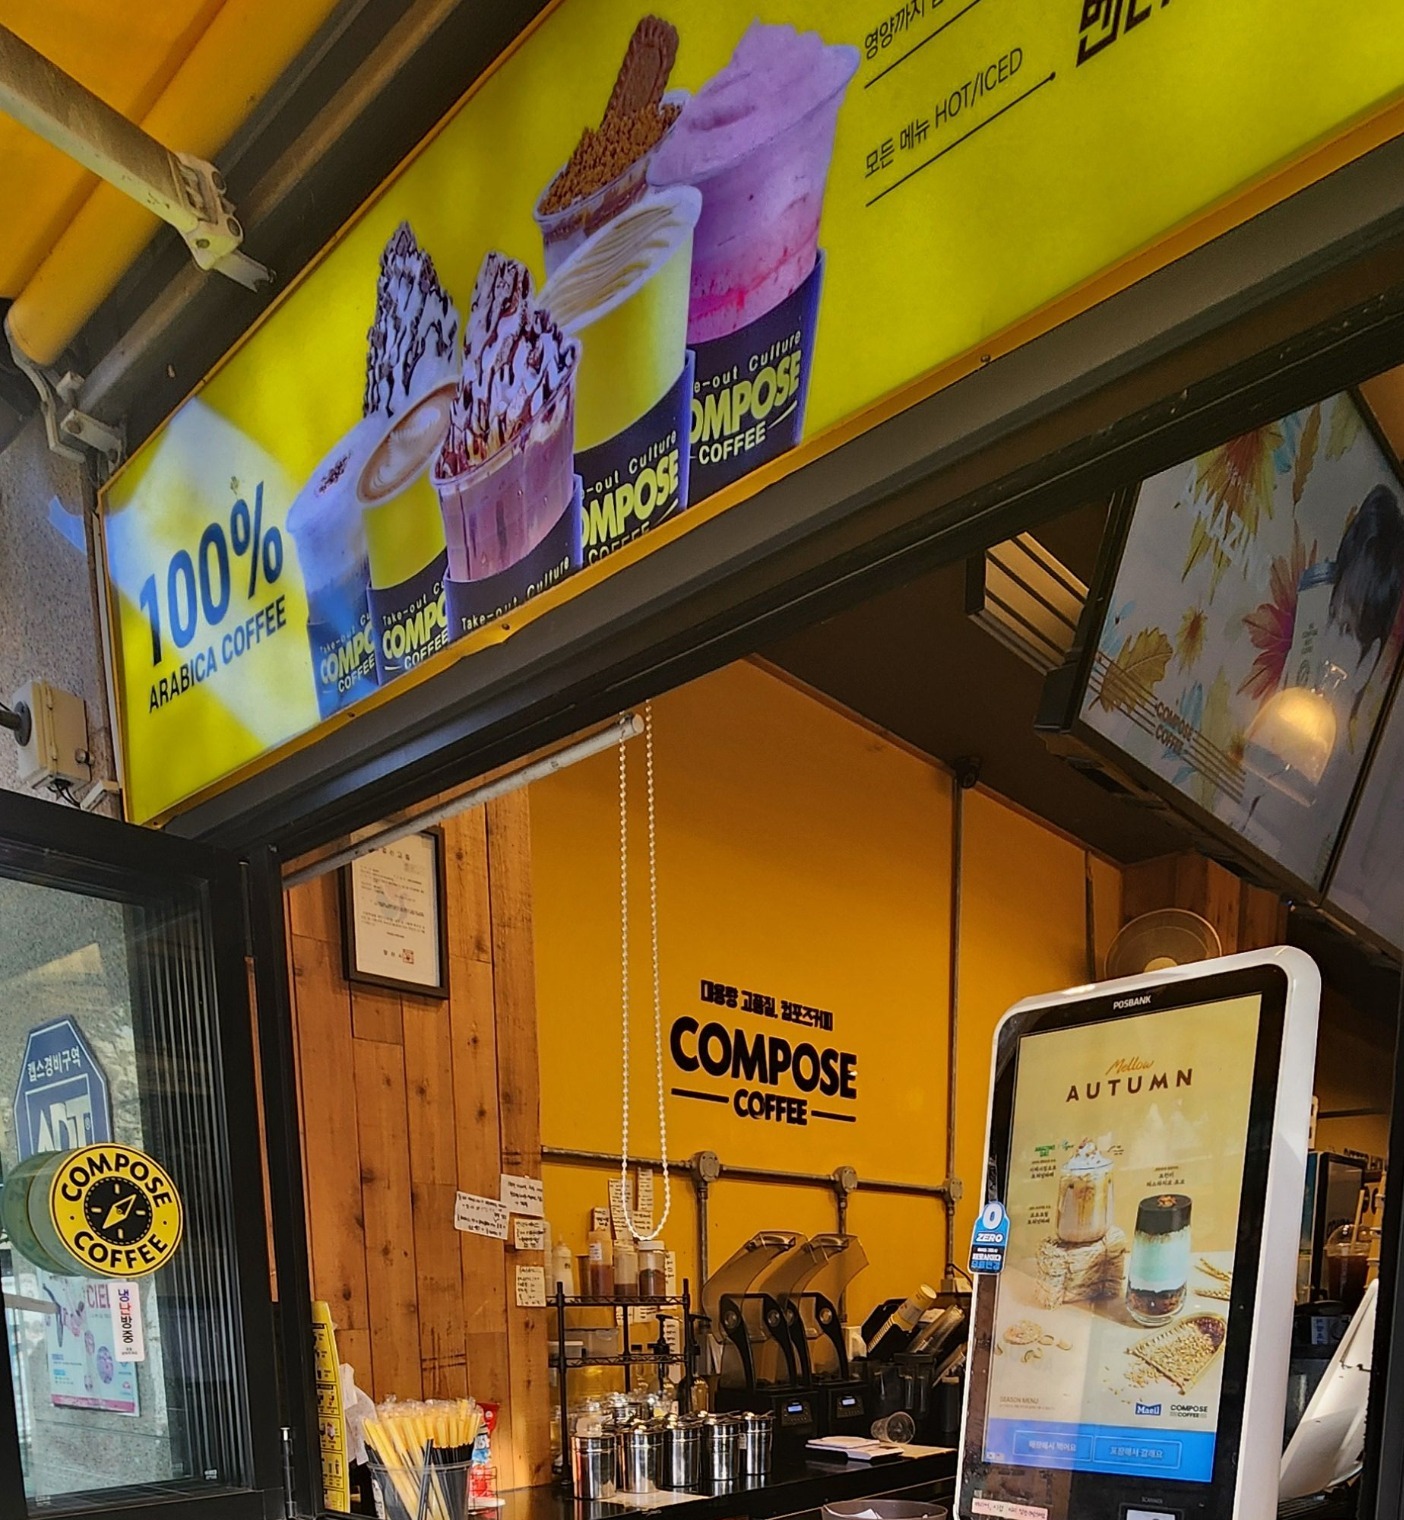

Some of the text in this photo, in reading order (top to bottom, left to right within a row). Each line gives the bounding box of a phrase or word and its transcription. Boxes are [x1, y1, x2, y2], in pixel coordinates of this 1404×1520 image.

[865, 0, 924, 59] 영양까지
[865, 47, 1023, 179] 모든 메뉴 HOT/ICED
[749, 330, 801, 372] Culture
[628, 429, 677, 473] Culture
[698, 421, 766, 465] COFFEE
[140, 481, 283, 667] 100%
[383, 594, 427, 626] Take-out
[149, 595, 287, 714] ARABICA COFFEE
[338, 653, 375, 692] COFFEE
[781, 1000, 833, 1031] 컴포즈커피
[1113, 995, 1152, 1010] POSBANK
[27, 1046, 81, 1083] 캡스경비구역
[670, 1016, 857, 1099] COMPOSE
[1105, 1056, 1154, 1076] Mellow
[1065, 1068, 1193, 1103] AUTUMN
[37, 1096, 94, 1154] ADT
[733, 1088, 808, 1125] COFFEE
[61, 1152, 173, 1209] COMPOSE
[73, 1230, 169, 1269] COFFEE
[976, 1233, 1003, 1243] ZERO
[117, 1288, 134, 1344] 냉난방중
[1136, 1405, 1160, 1416] Maeil
[1170, 1404, 1208, 1413] COMPOSE
